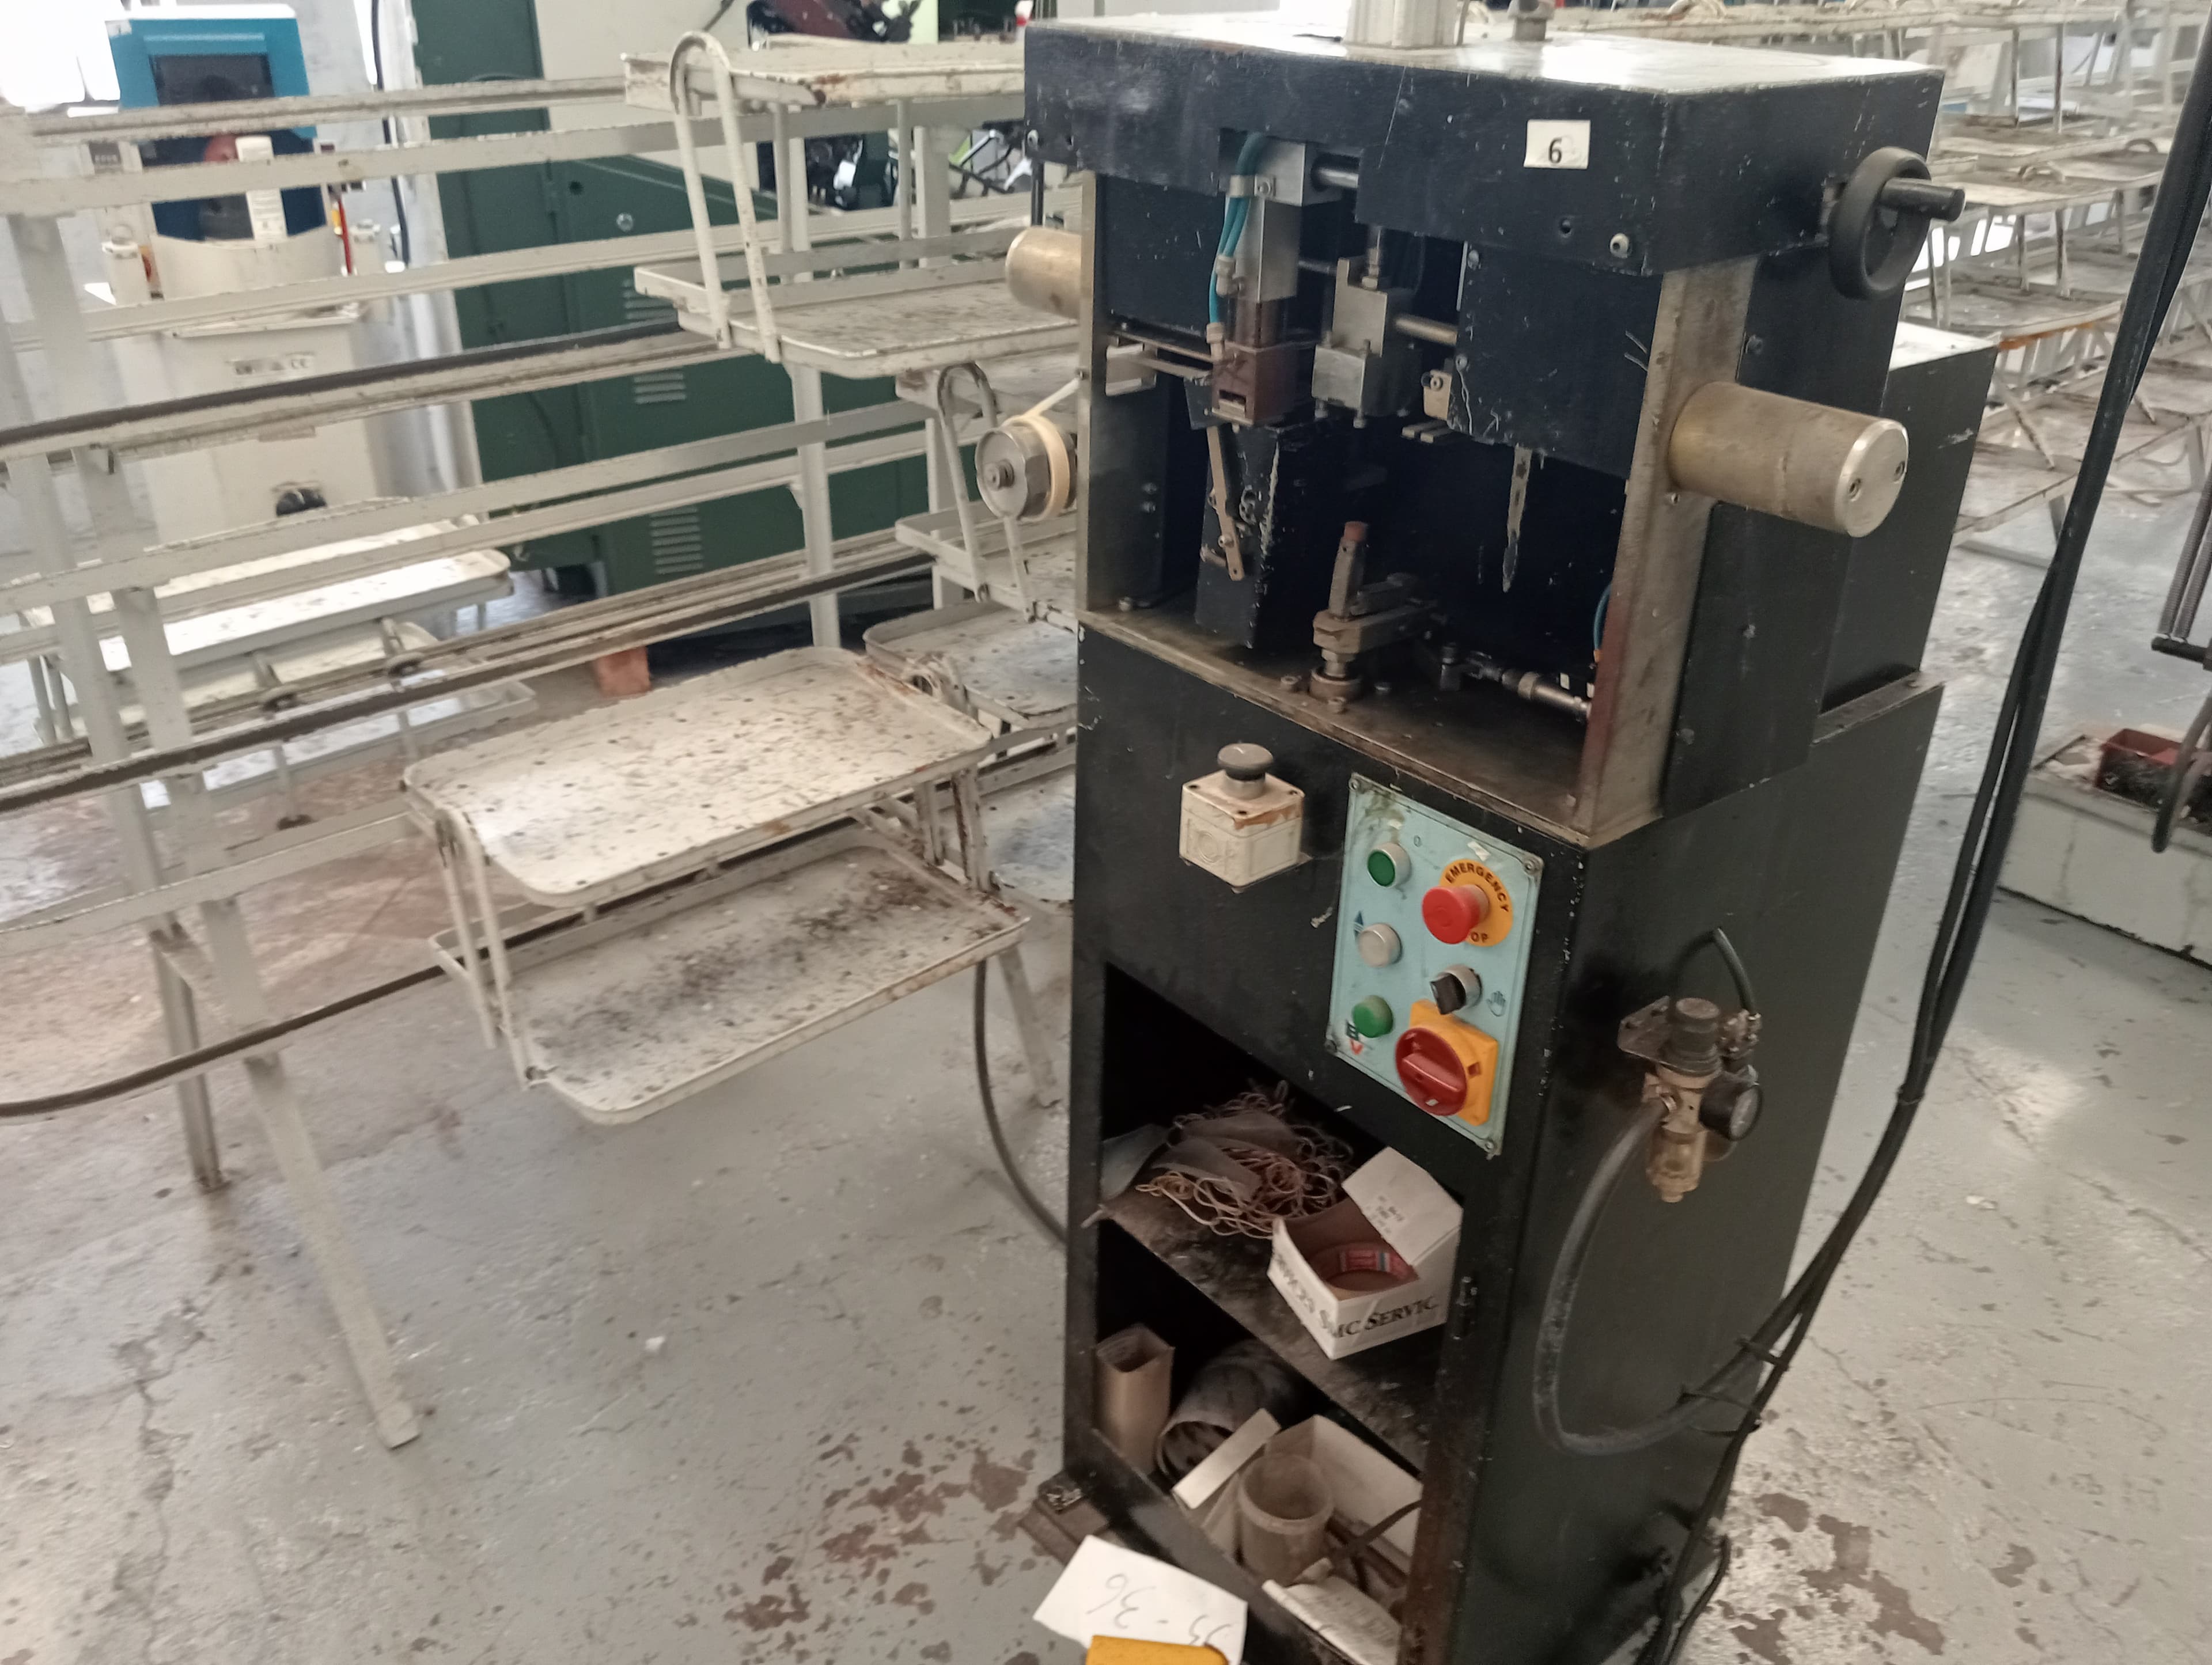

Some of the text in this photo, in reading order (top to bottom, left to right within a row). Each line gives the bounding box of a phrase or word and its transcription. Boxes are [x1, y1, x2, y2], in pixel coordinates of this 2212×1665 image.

[1549, 138, 1562, 164] 6
[1445, 862, 1509, 912] EMERGENCY
[1471, 932, 1488, 942] OP
